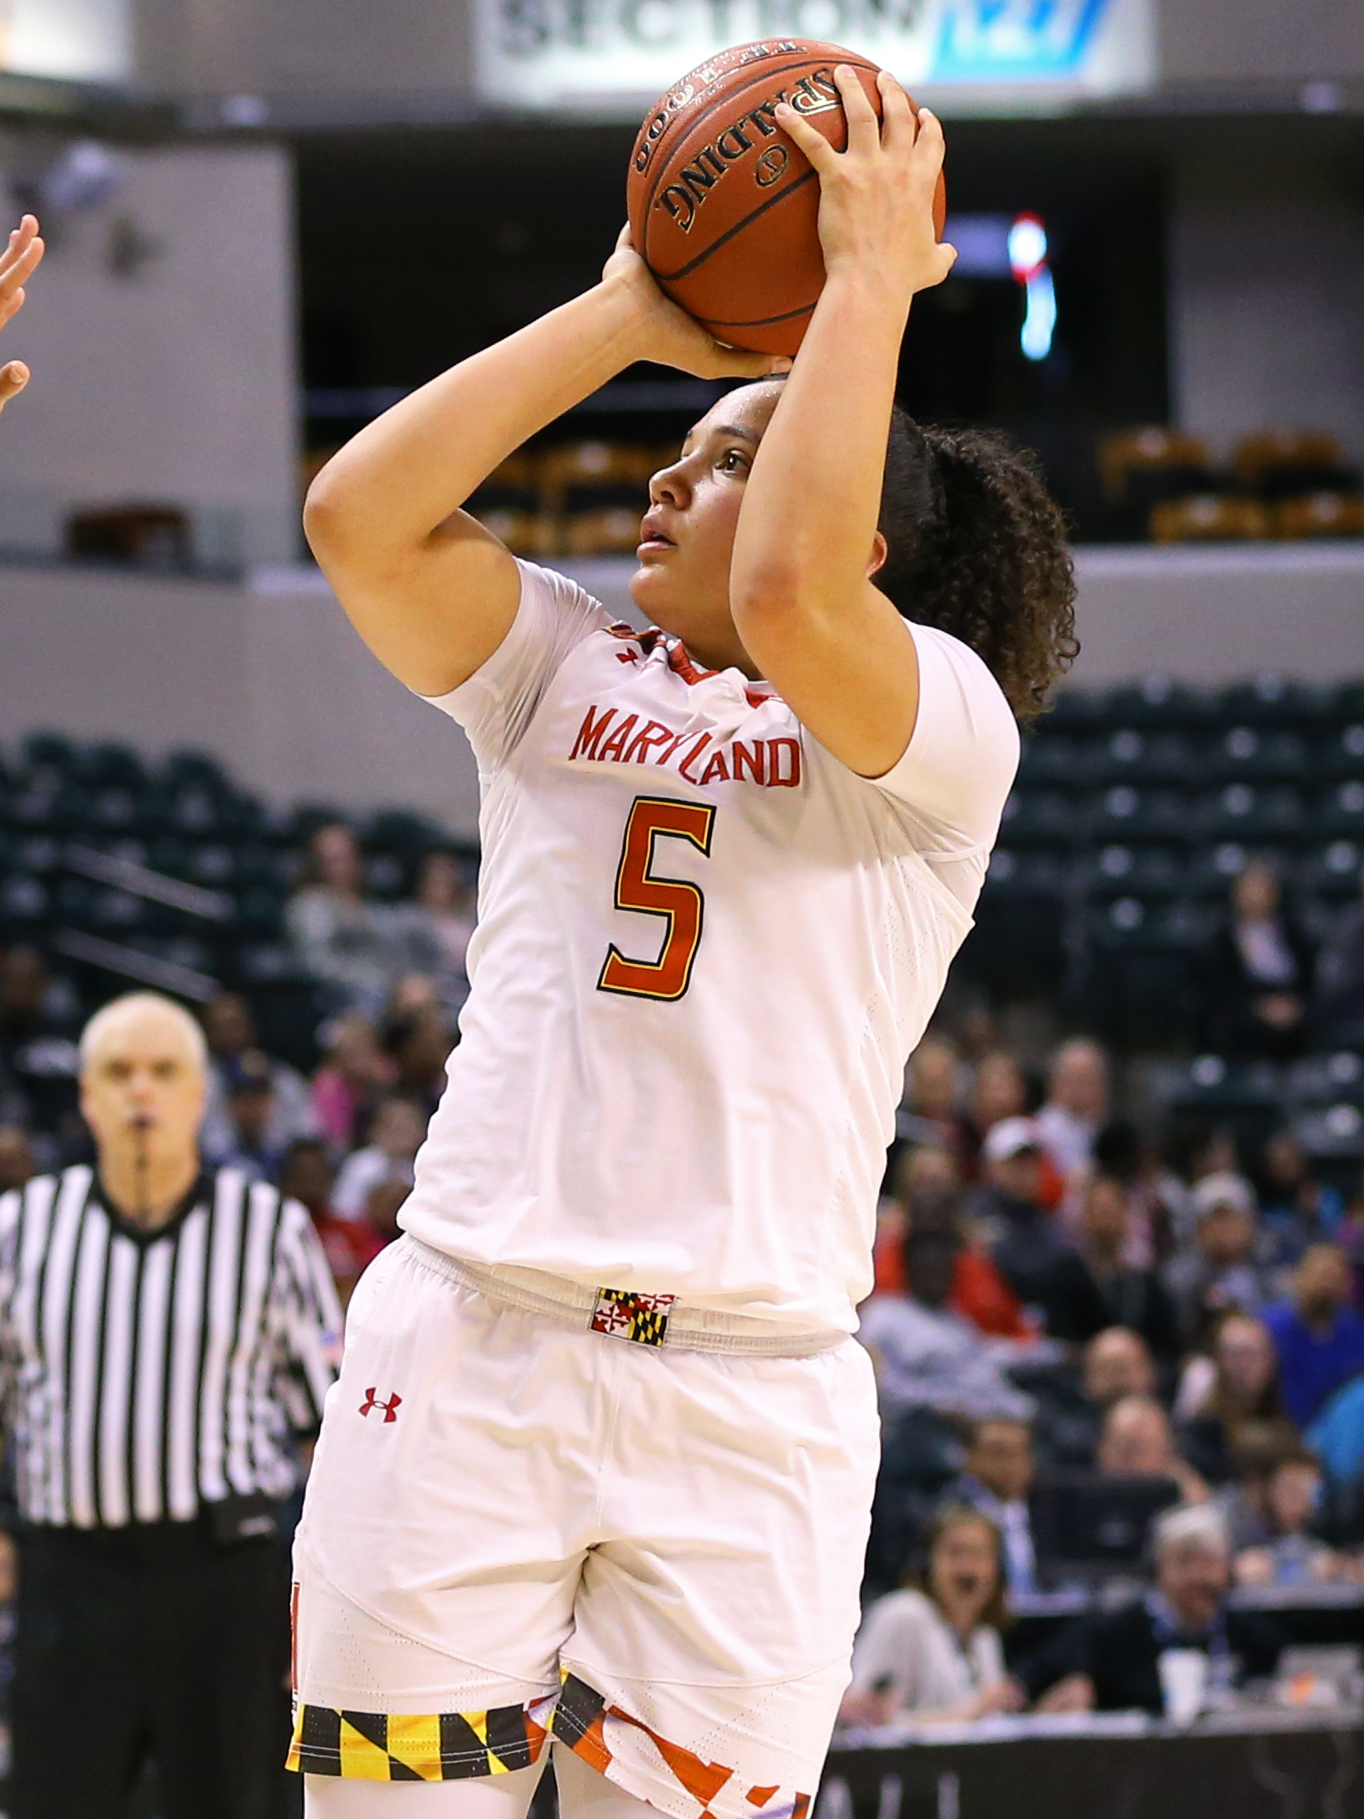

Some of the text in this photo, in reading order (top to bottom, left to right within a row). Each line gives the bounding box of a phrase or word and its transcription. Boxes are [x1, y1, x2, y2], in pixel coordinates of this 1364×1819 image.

[659, 68, 843, 233] SPALDING
[569, 705, 801, 788] MARYLAND
[597, 796, 716, 1001] 5
